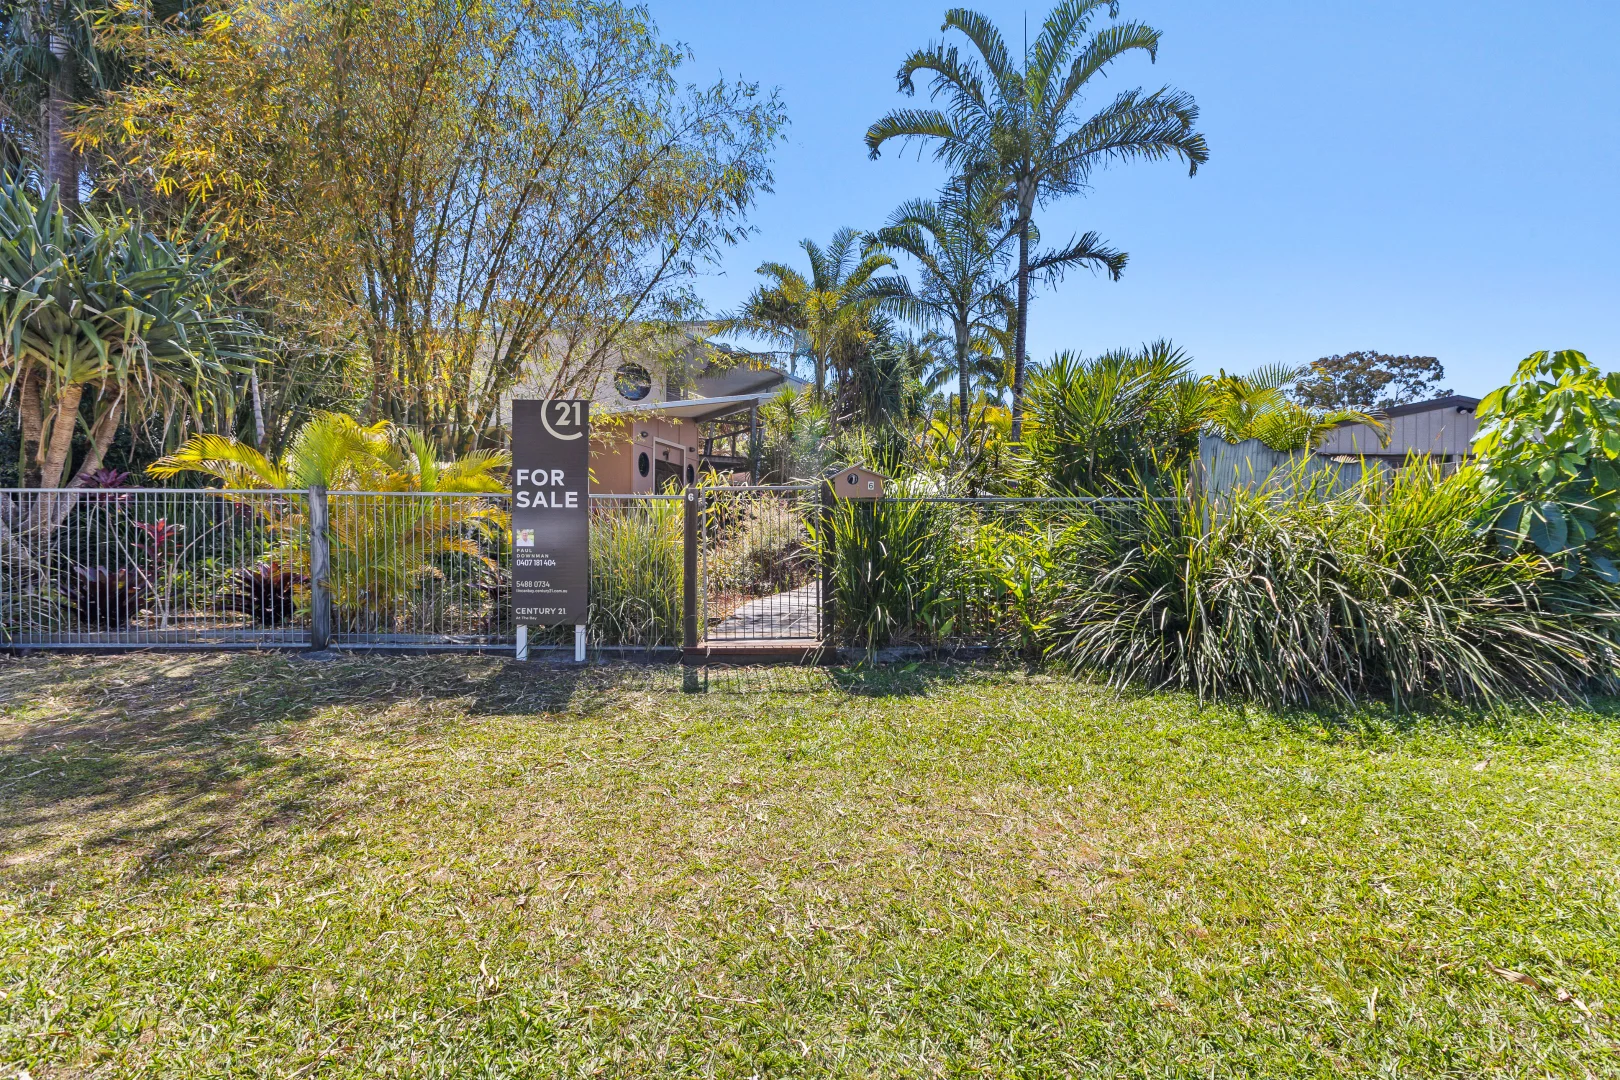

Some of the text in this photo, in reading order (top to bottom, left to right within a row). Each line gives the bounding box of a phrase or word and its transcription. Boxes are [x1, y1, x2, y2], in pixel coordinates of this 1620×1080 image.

[516, 468, 565, 486] FOR
[868, 482, 875, 490] 6
[516, 490, 579, 508] SALE
[687, 493, 695, 502] 6
[516, 559, 556, 567] 0407 181 404
[516, 580, 550, 588] 5488 0734
[515, 607, 557, 615] CENTURY
